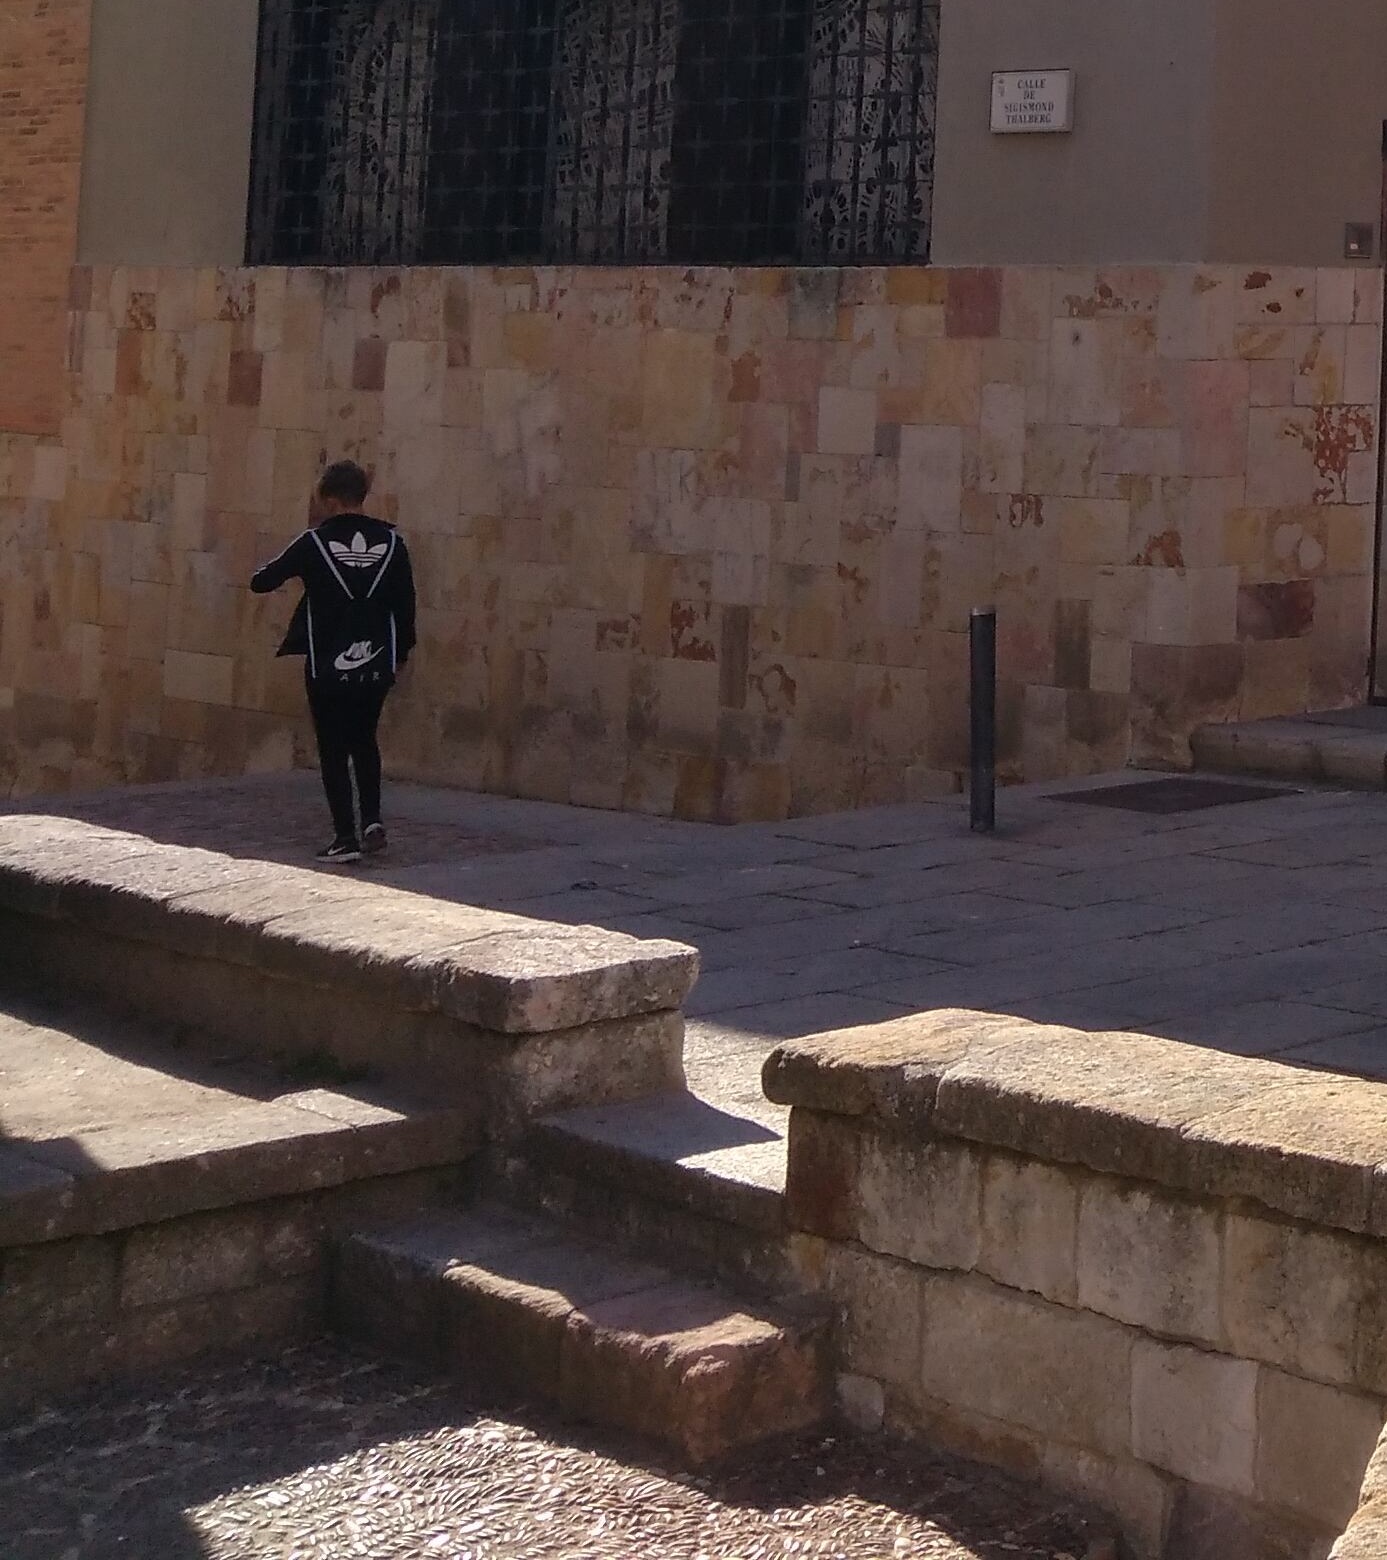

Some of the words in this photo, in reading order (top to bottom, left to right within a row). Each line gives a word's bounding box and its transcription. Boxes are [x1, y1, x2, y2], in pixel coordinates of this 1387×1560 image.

[1017, 78, 1046, 89] CALLE
[1023, 90, 1036, 100] DE
[340, 671, 380, 682] AIR
